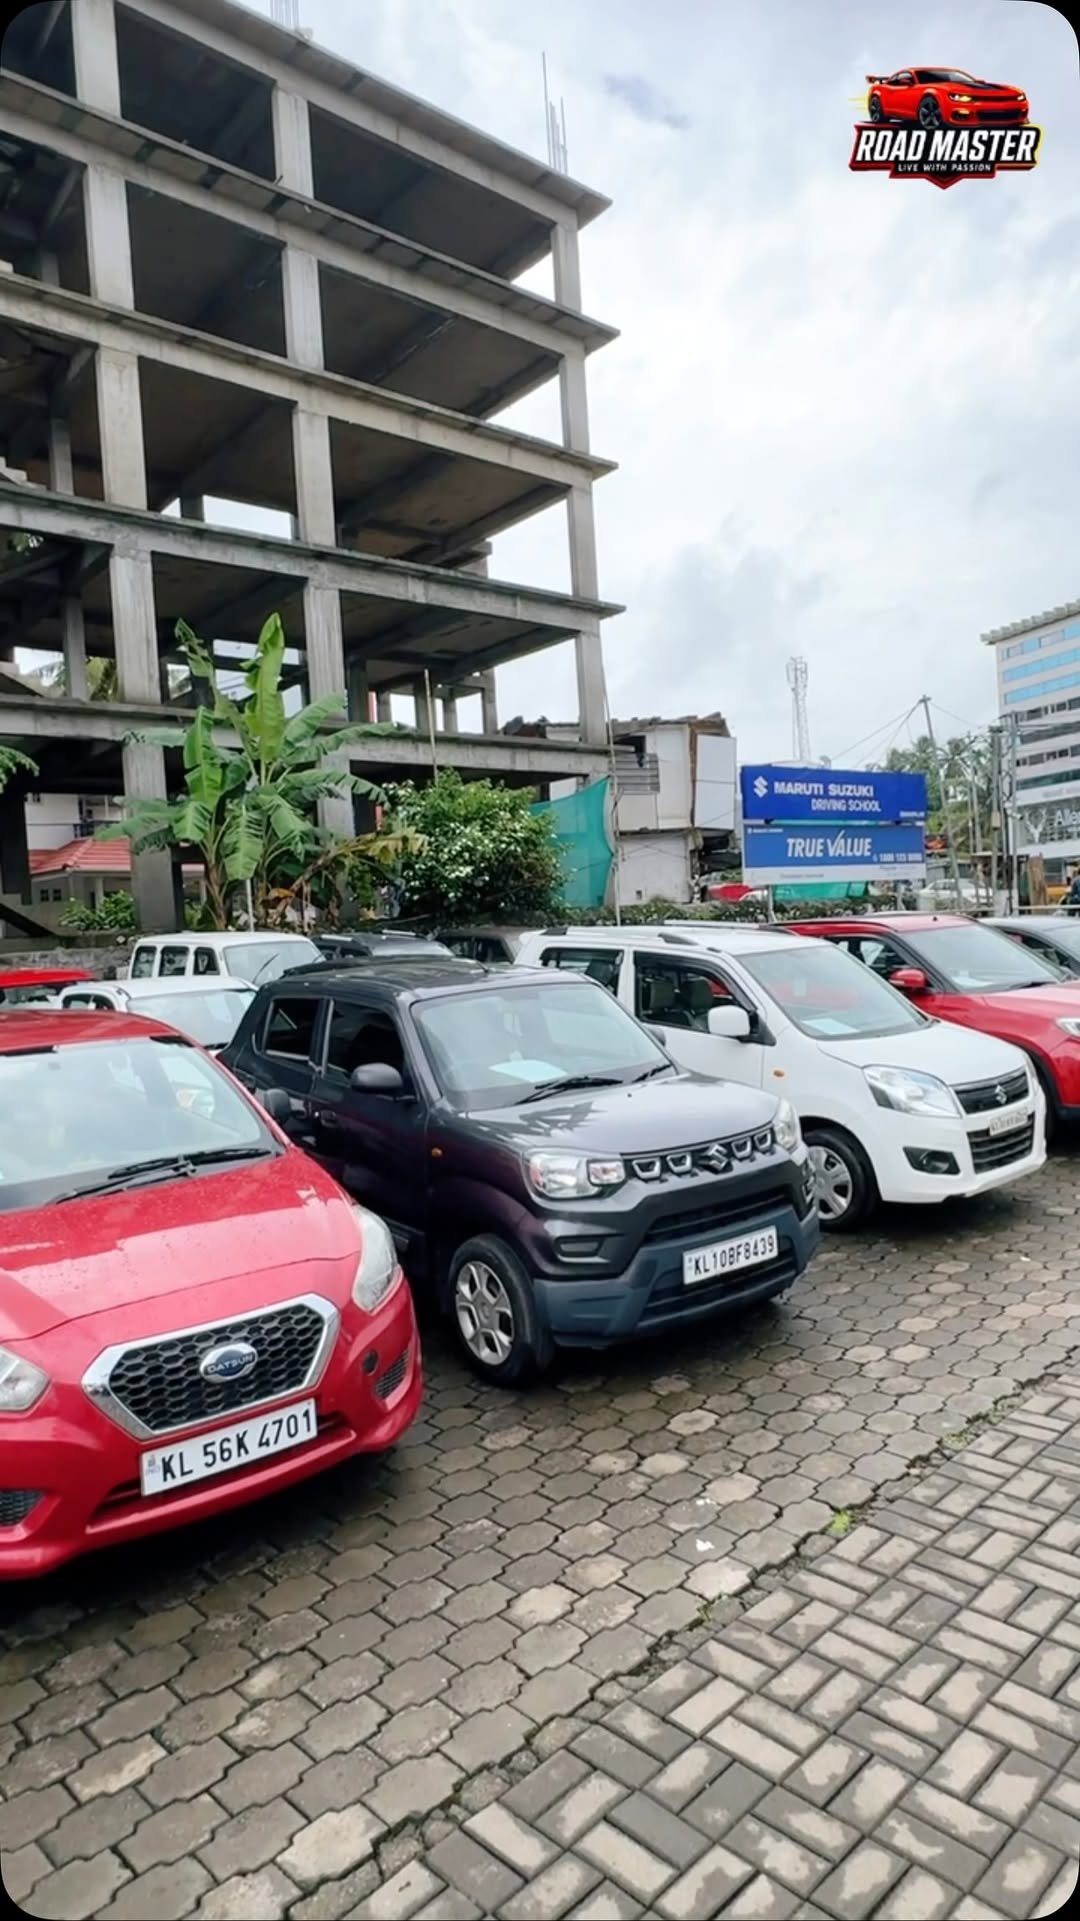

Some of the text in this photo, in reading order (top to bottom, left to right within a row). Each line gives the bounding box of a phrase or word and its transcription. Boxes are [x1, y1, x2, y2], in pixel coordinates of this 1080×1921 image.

[774, 781, 874, 797] MARUTI SUZUKI
[811, 798, 881, 812] DRIVING SCHOOL
[786, 830, 872, 858] TRUE VALUE
[206, 1352, 254, 1375] DATSUN
[161, 1408, 311, 1482] KL 56K 4701
